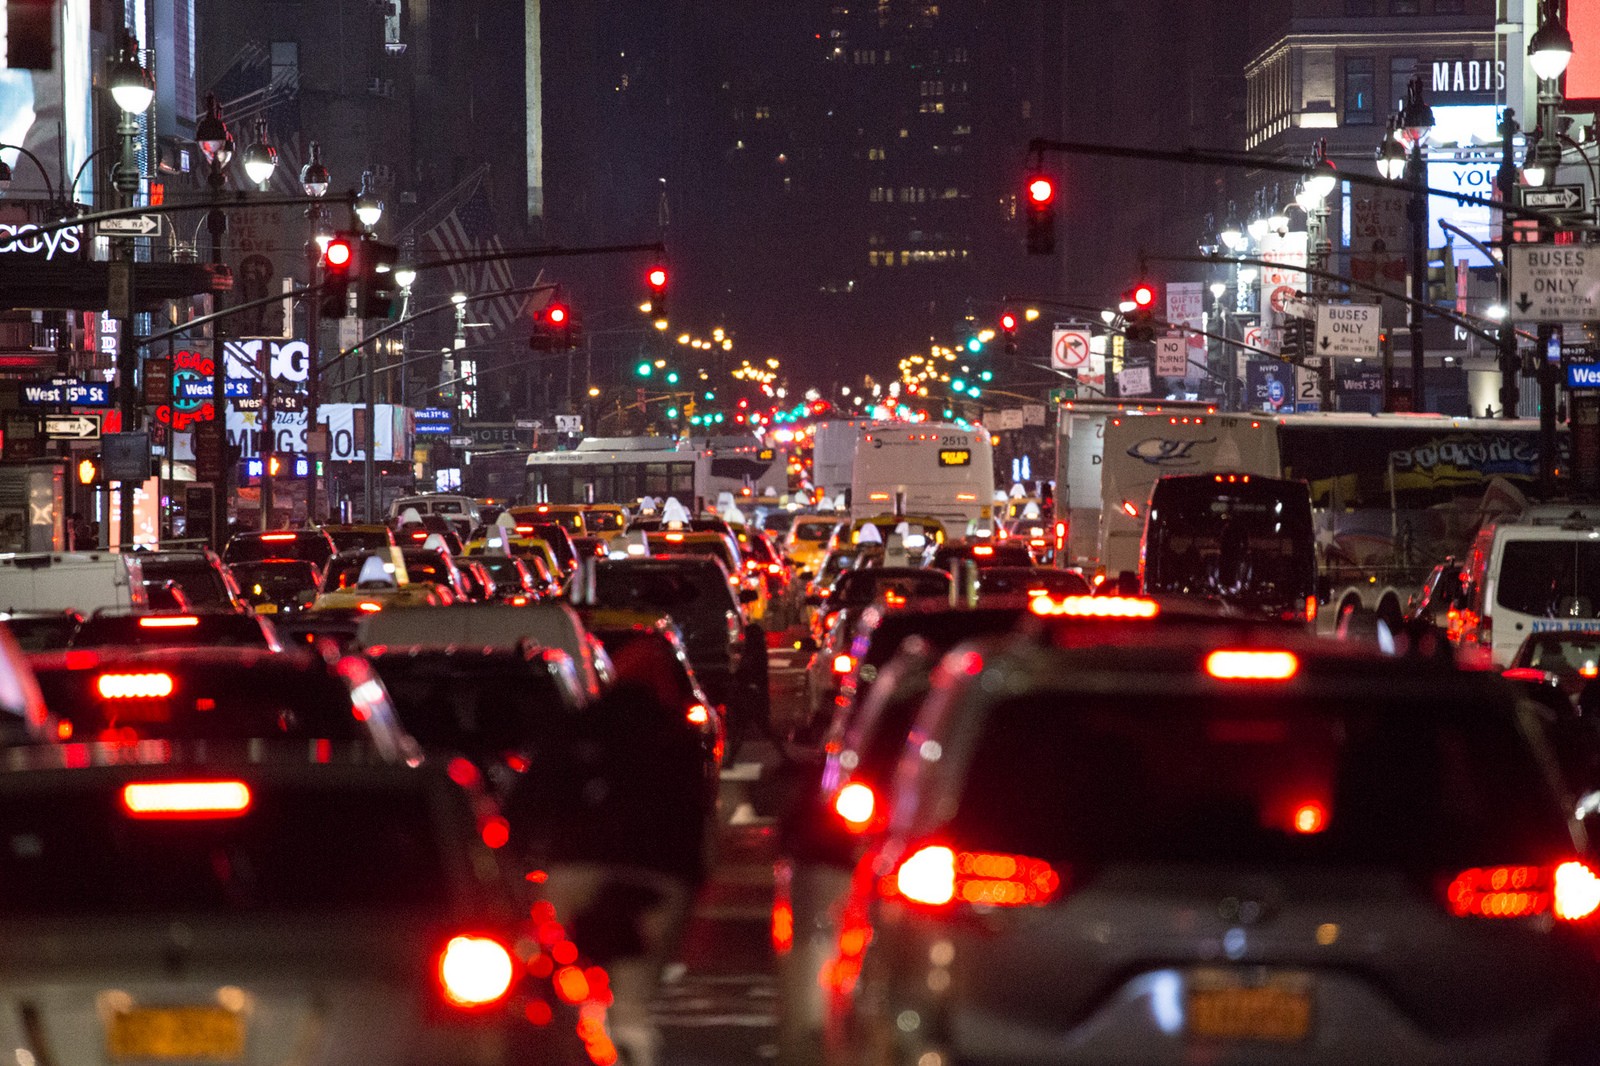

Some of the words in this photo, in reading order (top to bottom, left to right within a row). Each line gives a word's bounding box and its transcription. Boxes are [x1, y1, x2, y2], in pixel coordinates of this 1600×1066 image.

[1531, 195, 1546, 205] ONE
[1555, 193, 1574, 204] WAY
[105, 220, 122, 228] ONE
[1528, 251, 1585, 267] BUSES
[1534, 278, 1578, 293] ONLY
[1170, 304, 1186, 312] WE
[1329, 309, 1368, 321] BUSES
[1333, 322, 1363, 334] ONLY
[1164, 343, 1179, 352] NO
[1159, 355, 1184, 363] TURNS
[186, 384, 212, 395] West
[236, 382, 248, 394] St
[1343, 379, 1367, 389] West
[1369, 379, 1383, 389] 34
[26, 387, 60, 401] West
[89, 387, 104, 401] St
[1302, 382, 1321, 398] 2
[239, 398, 262, 408] Wes
[285, 398, 296, 408] St
[70, 423, 88, 431] WAY
[471, 430, 517, 441] HOTEL
[942, 436, 968, 446] 2513
